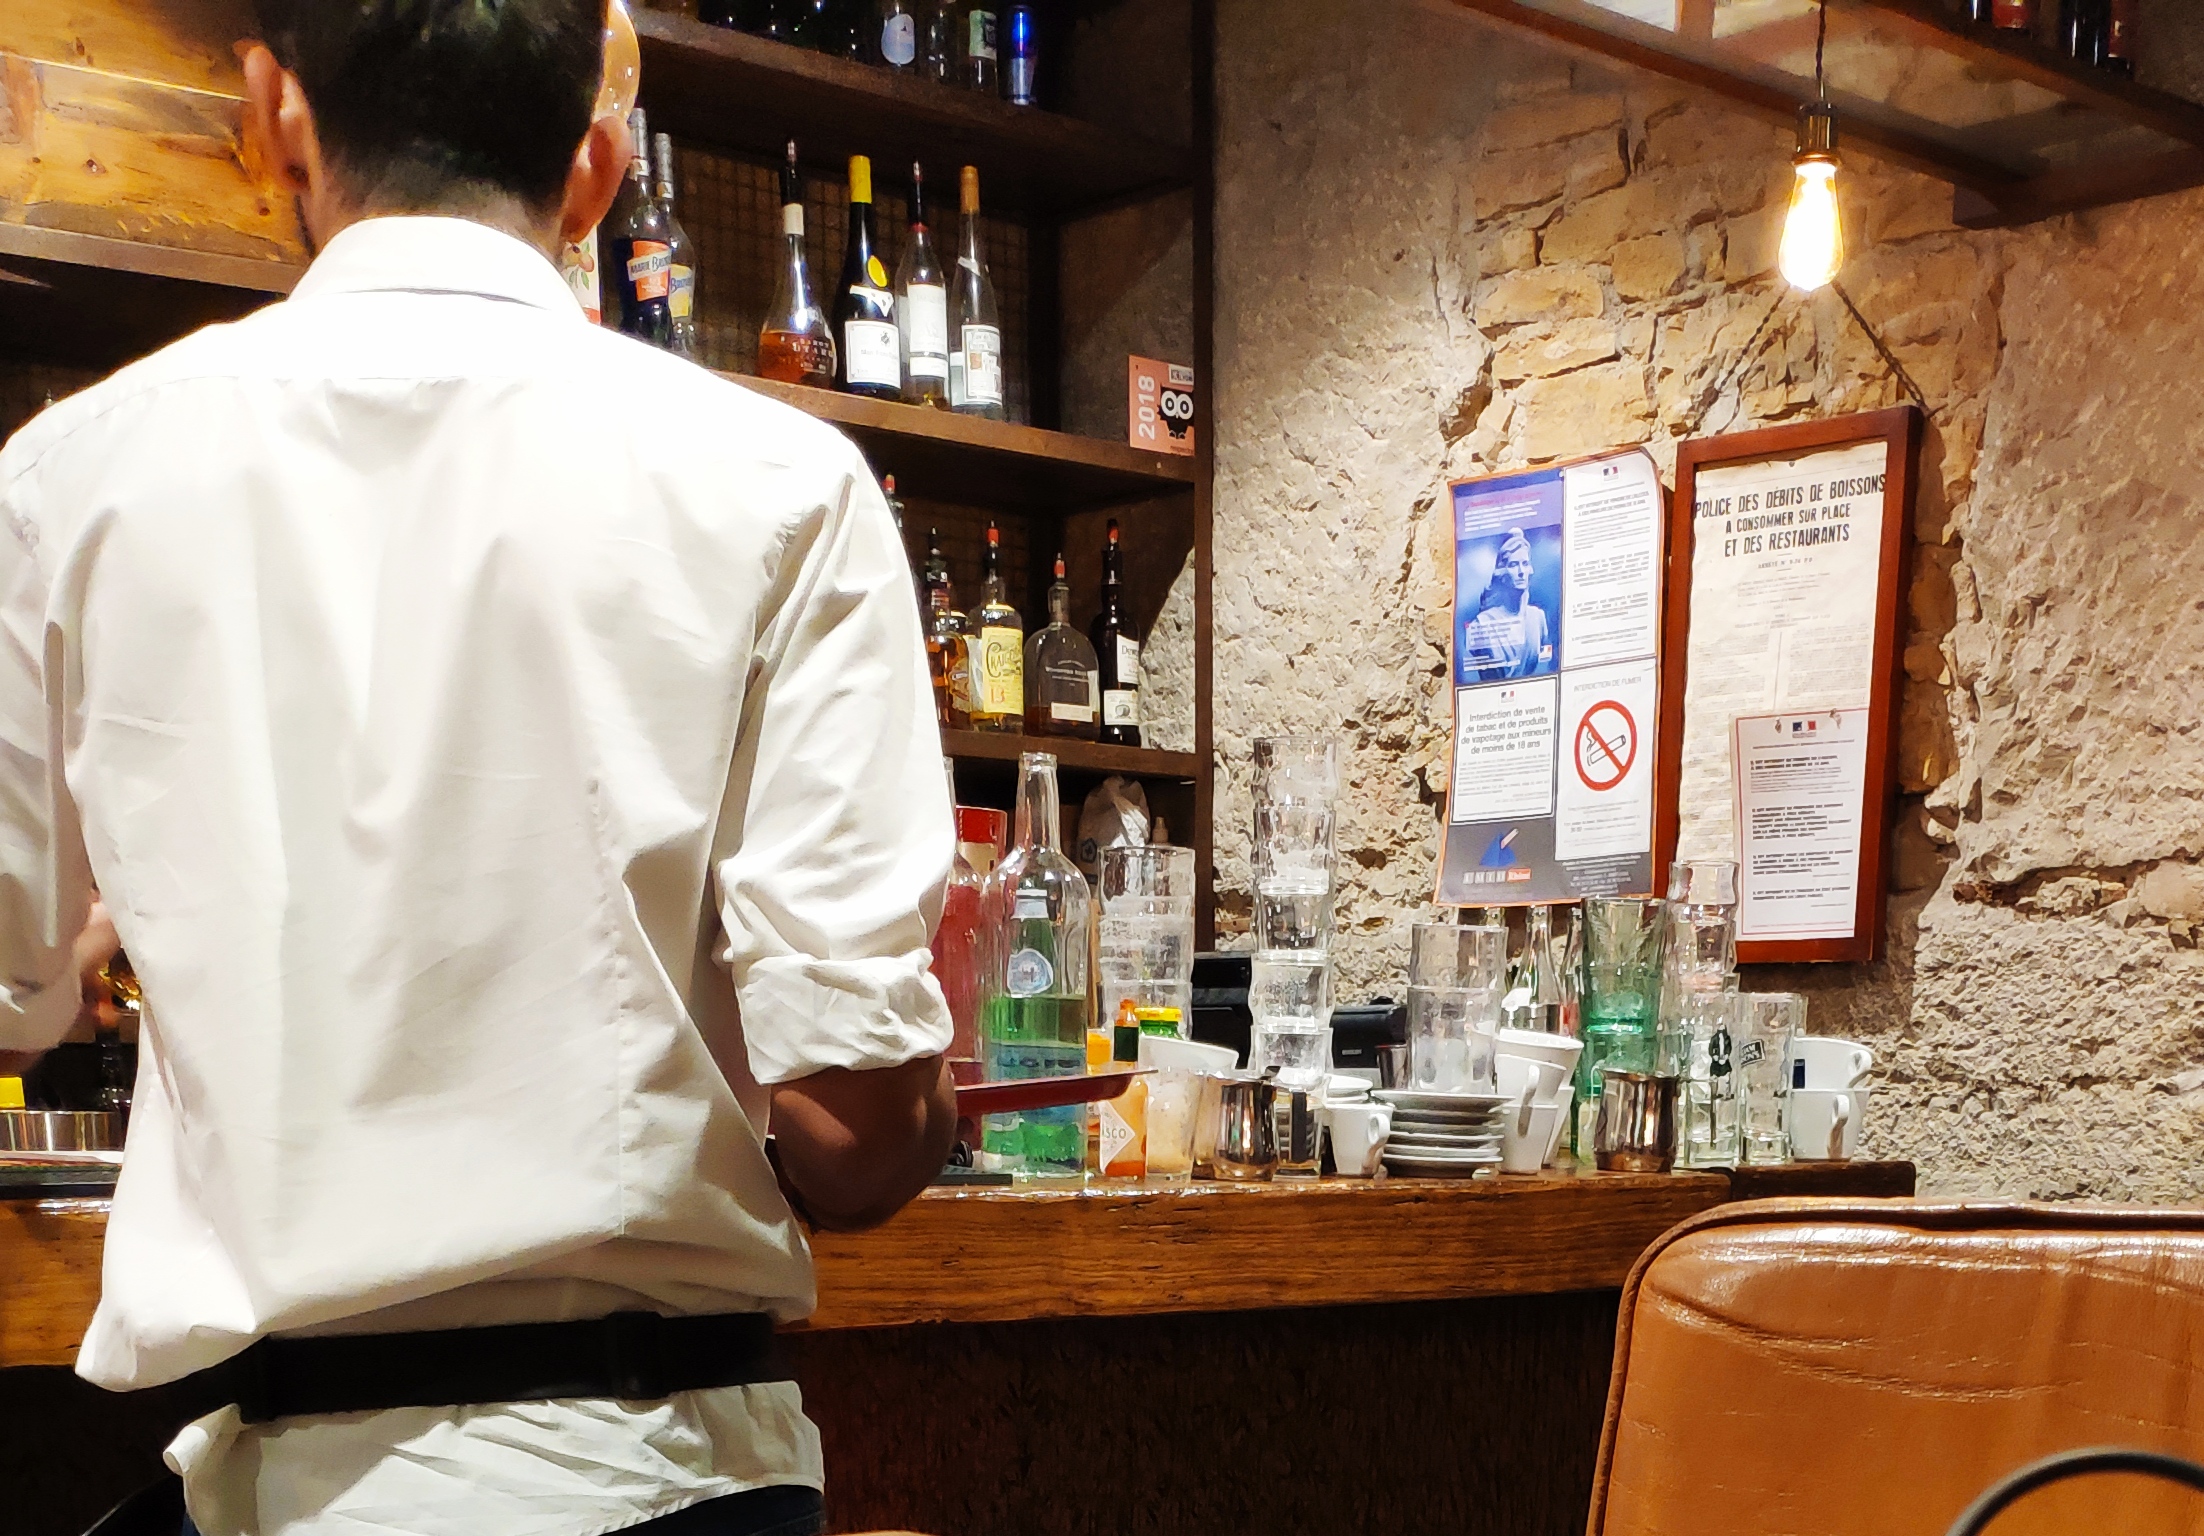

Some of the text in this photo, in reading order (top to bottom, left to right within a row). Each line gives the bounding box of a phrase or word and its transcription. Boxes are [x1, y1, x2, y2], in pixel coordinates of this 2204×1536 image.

[1138, 375, 1155, 440] 2018
[1694, 474, 1886, 519] POLICE DES DÉBITS DE BOISSONS
[1725, 502, 1851, 534] A CONSOMMER SUR PLACE
[1724, 523, 1850, 557] ET DES RESTAURANTS
[1573, 676, 1642, 692] INTERDICTION DE FUMER
[1469, 706, 1545, 722] Interdiction de vente
[1465, 716, 1548, 734] de tabac et de produits
[1461, 728, 1551, 745] de vapotage aux mineurs
[1470, 740, 1540, 755] de moins de 18 ans
